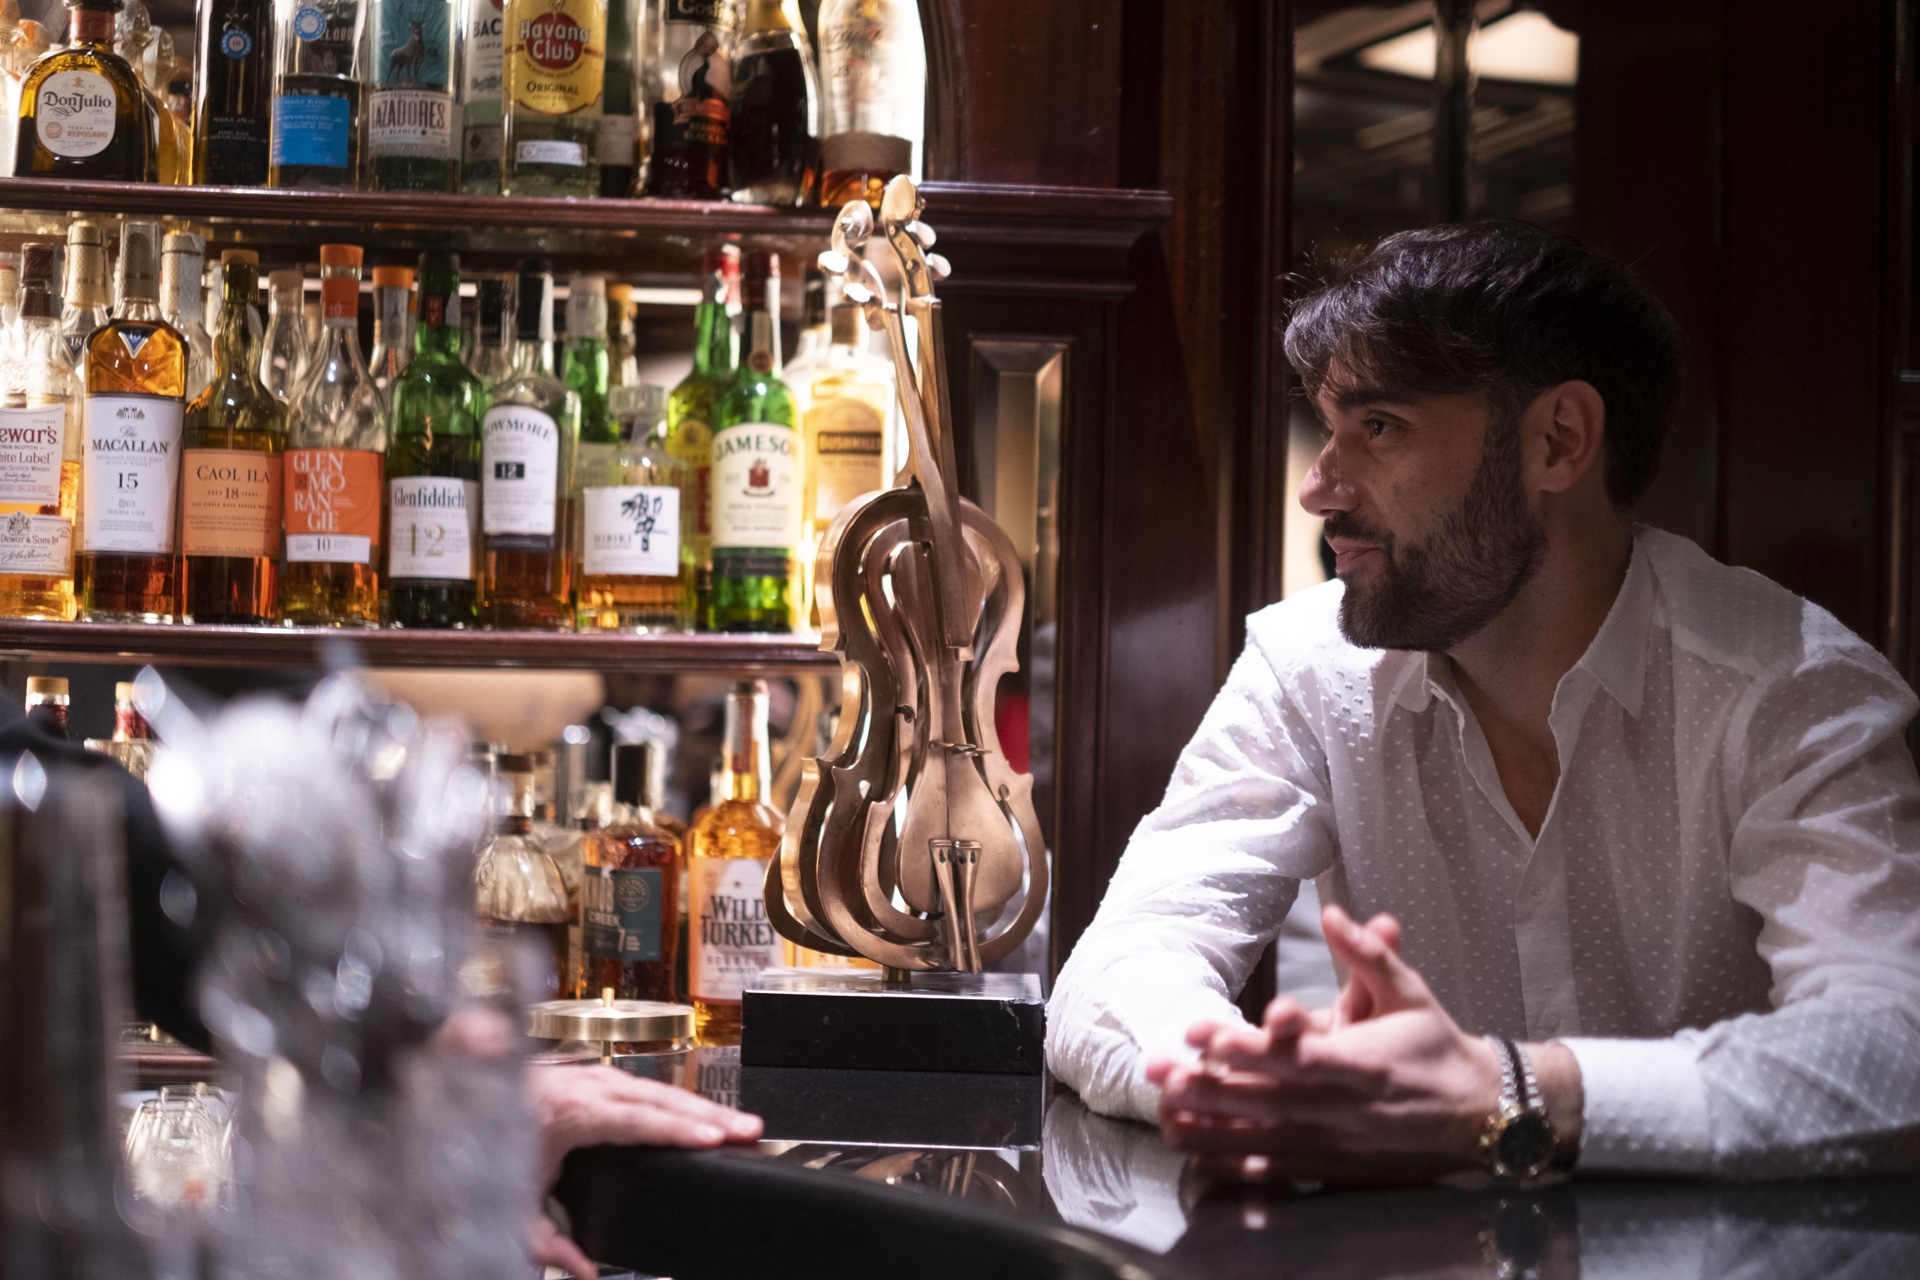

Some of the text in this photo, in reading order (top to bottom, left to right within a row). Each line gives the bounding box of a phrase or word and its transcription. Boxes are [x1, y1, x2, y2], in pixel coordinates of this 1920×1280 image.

[473, 18, 502, 38] BAC
[518, 19, 590, 43] Havana
[532, 40, 576, 61] Club
[526, 81, 579, 95] ORIGINAL
[67, 131, 109, 139] REPOSADO
[70, 336, 82, 348] 18
[119, 425, 138, 438] The
[92, 438, 169, 454] MACALLAN
[716, 434, 798, 461] JAMESO
[19, 452, 50, 464] Label
[293, 450, 344, 474] GLEN
[115, 471, 139, 490] 15
[197, 465, 271, 484] CAOL ILA
[308, 472, 346, 493] MO
[226, 487, 240, 499] 18
[293, 491, 332, 513] RAN
[394, 484, 465, 509] Glenfiddich
[308, 510, 339, 533] GIE
[32, 535, 51, 544] Sons
[317, 538, 331, 553] 10
[410, 521, 446, 558] 12
[594, 534, 632, 544] HIBIKI
[710, 894, 768, 921] WILD
[588, 911, 619, 927] CREEK
[701, 915, 776, 949] TURKEY
